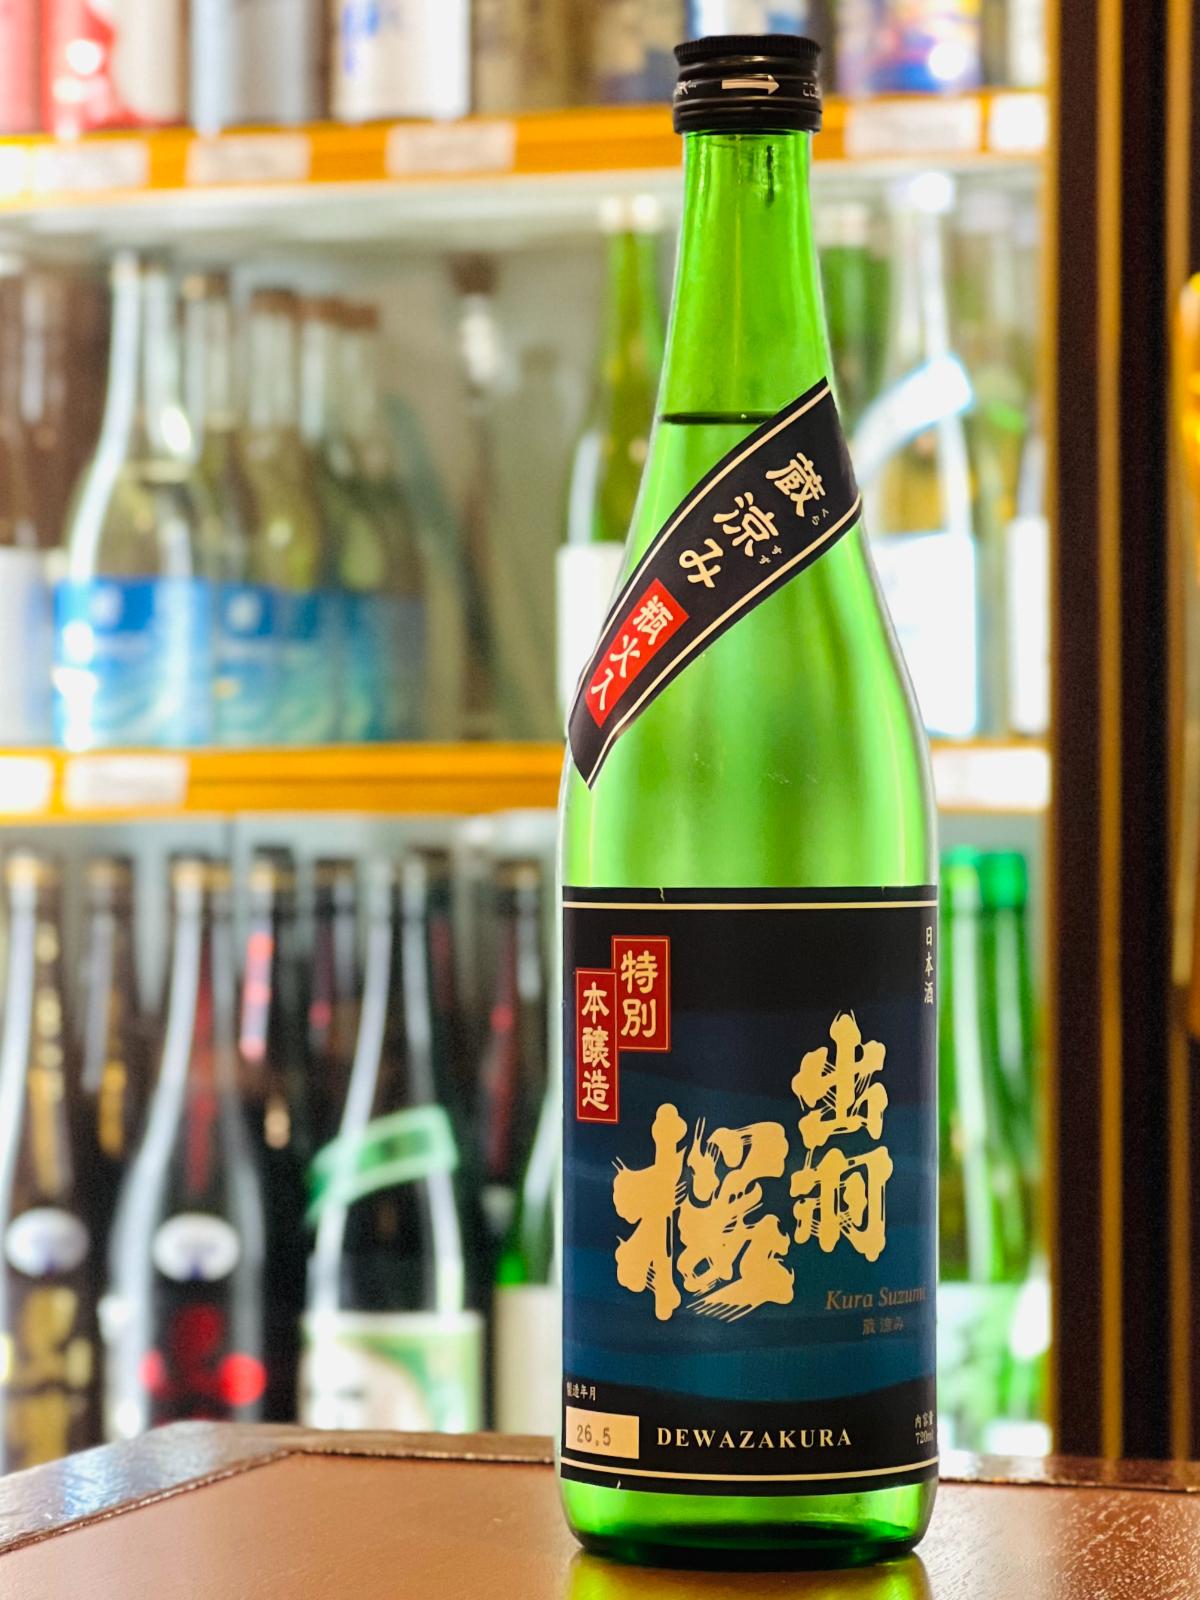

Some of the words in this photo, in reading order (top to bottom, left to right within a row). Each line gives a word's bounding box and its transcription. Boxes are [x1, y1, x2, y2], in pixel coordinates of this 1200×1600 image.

[679, 451, 826, 589] 蔵涼み
[590, 594, 674, 711] 瓶火入
[620, 949, 659, 1038] 特別
[924, 926, 934, 1005] 日本酒
[581, 981, 611, 1112] 本醸造
[824, 1289, 874, 1311] Kura
[576, 1423, 612, 1447] 26.5
[657, 1427, 852, 1449] DEWAZAKURA
